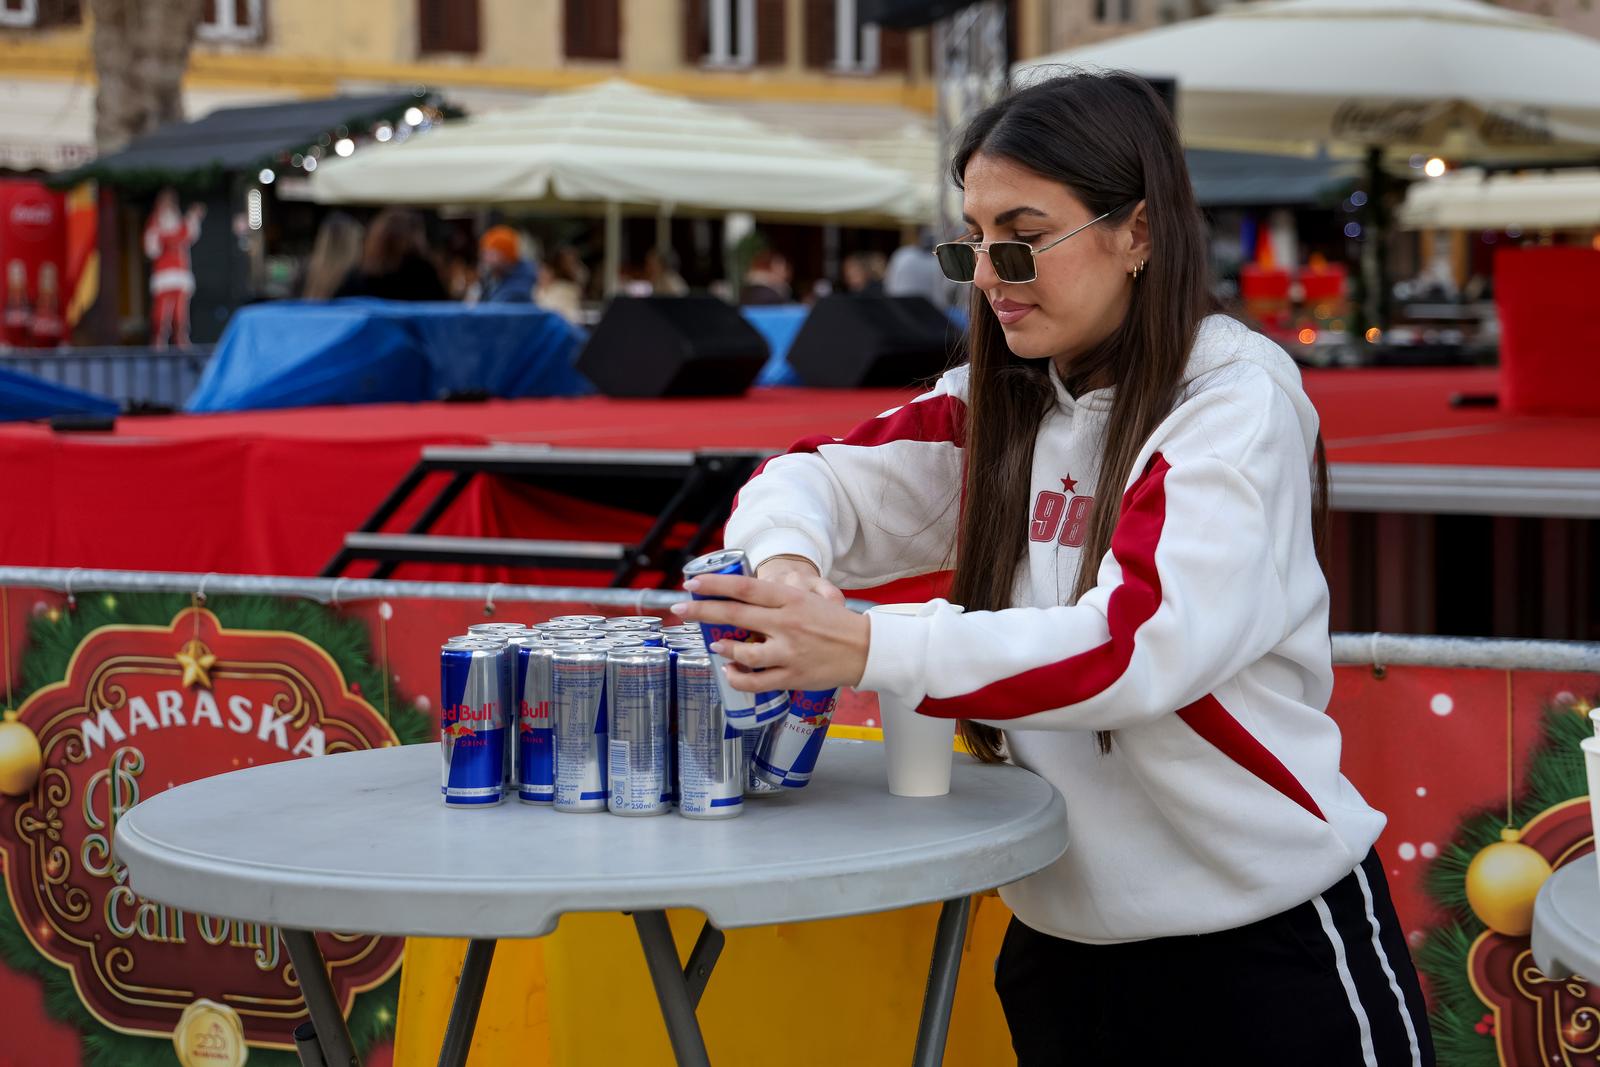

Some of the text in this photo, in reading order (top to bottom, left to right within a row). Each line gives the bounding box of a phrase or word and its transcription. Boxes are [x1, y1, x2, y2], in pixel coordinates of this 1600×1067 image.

[459, 703, 492, 721] Bull
[520, 701, 549, 719] Bull
[81, 690, 325, 758] MARASKA
[784, 721, 818, 738] ENERG
